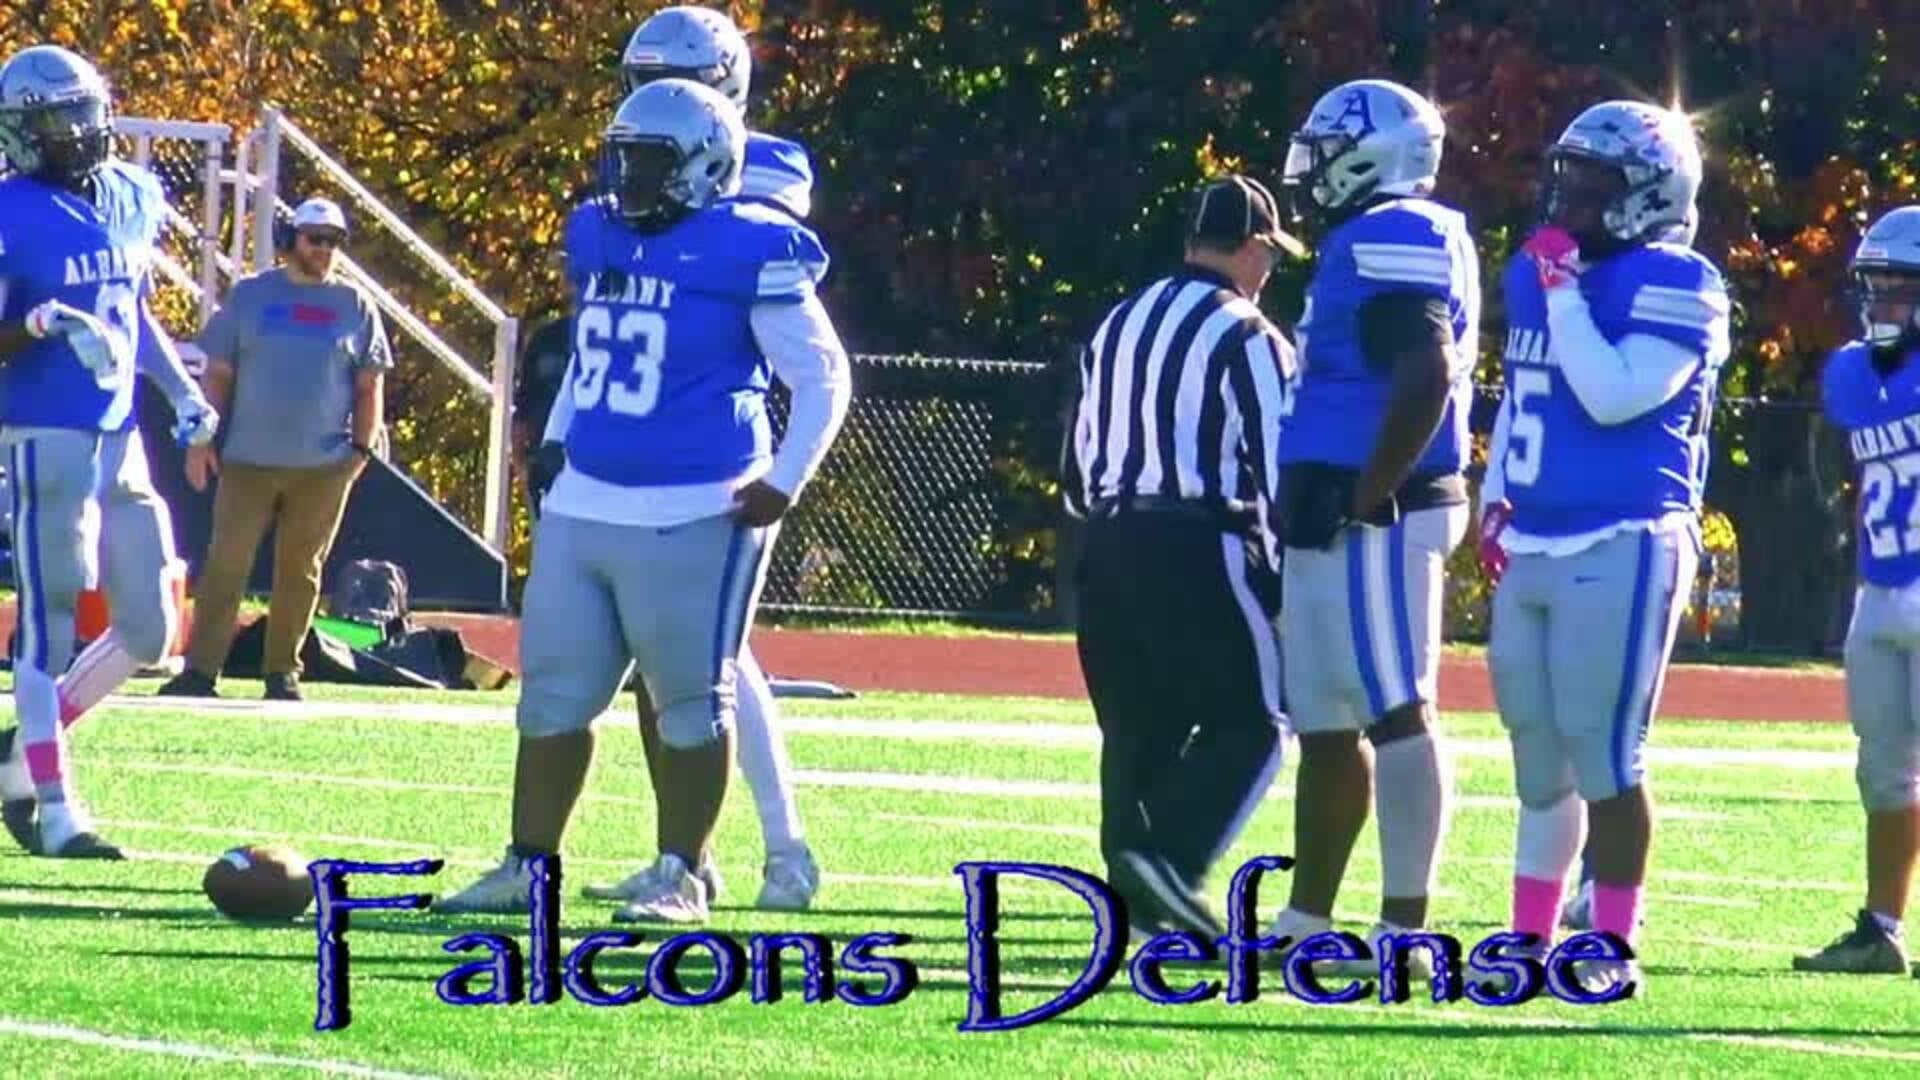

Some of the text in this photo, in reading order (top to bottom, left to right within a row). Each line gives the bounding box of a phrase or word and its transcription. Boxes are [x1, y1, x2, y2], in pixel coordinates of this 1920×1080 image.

[1329, 89, 1377, 142] A
[573, 304, 667, 416] 63
[1863, 452, 1920, 559] 27
